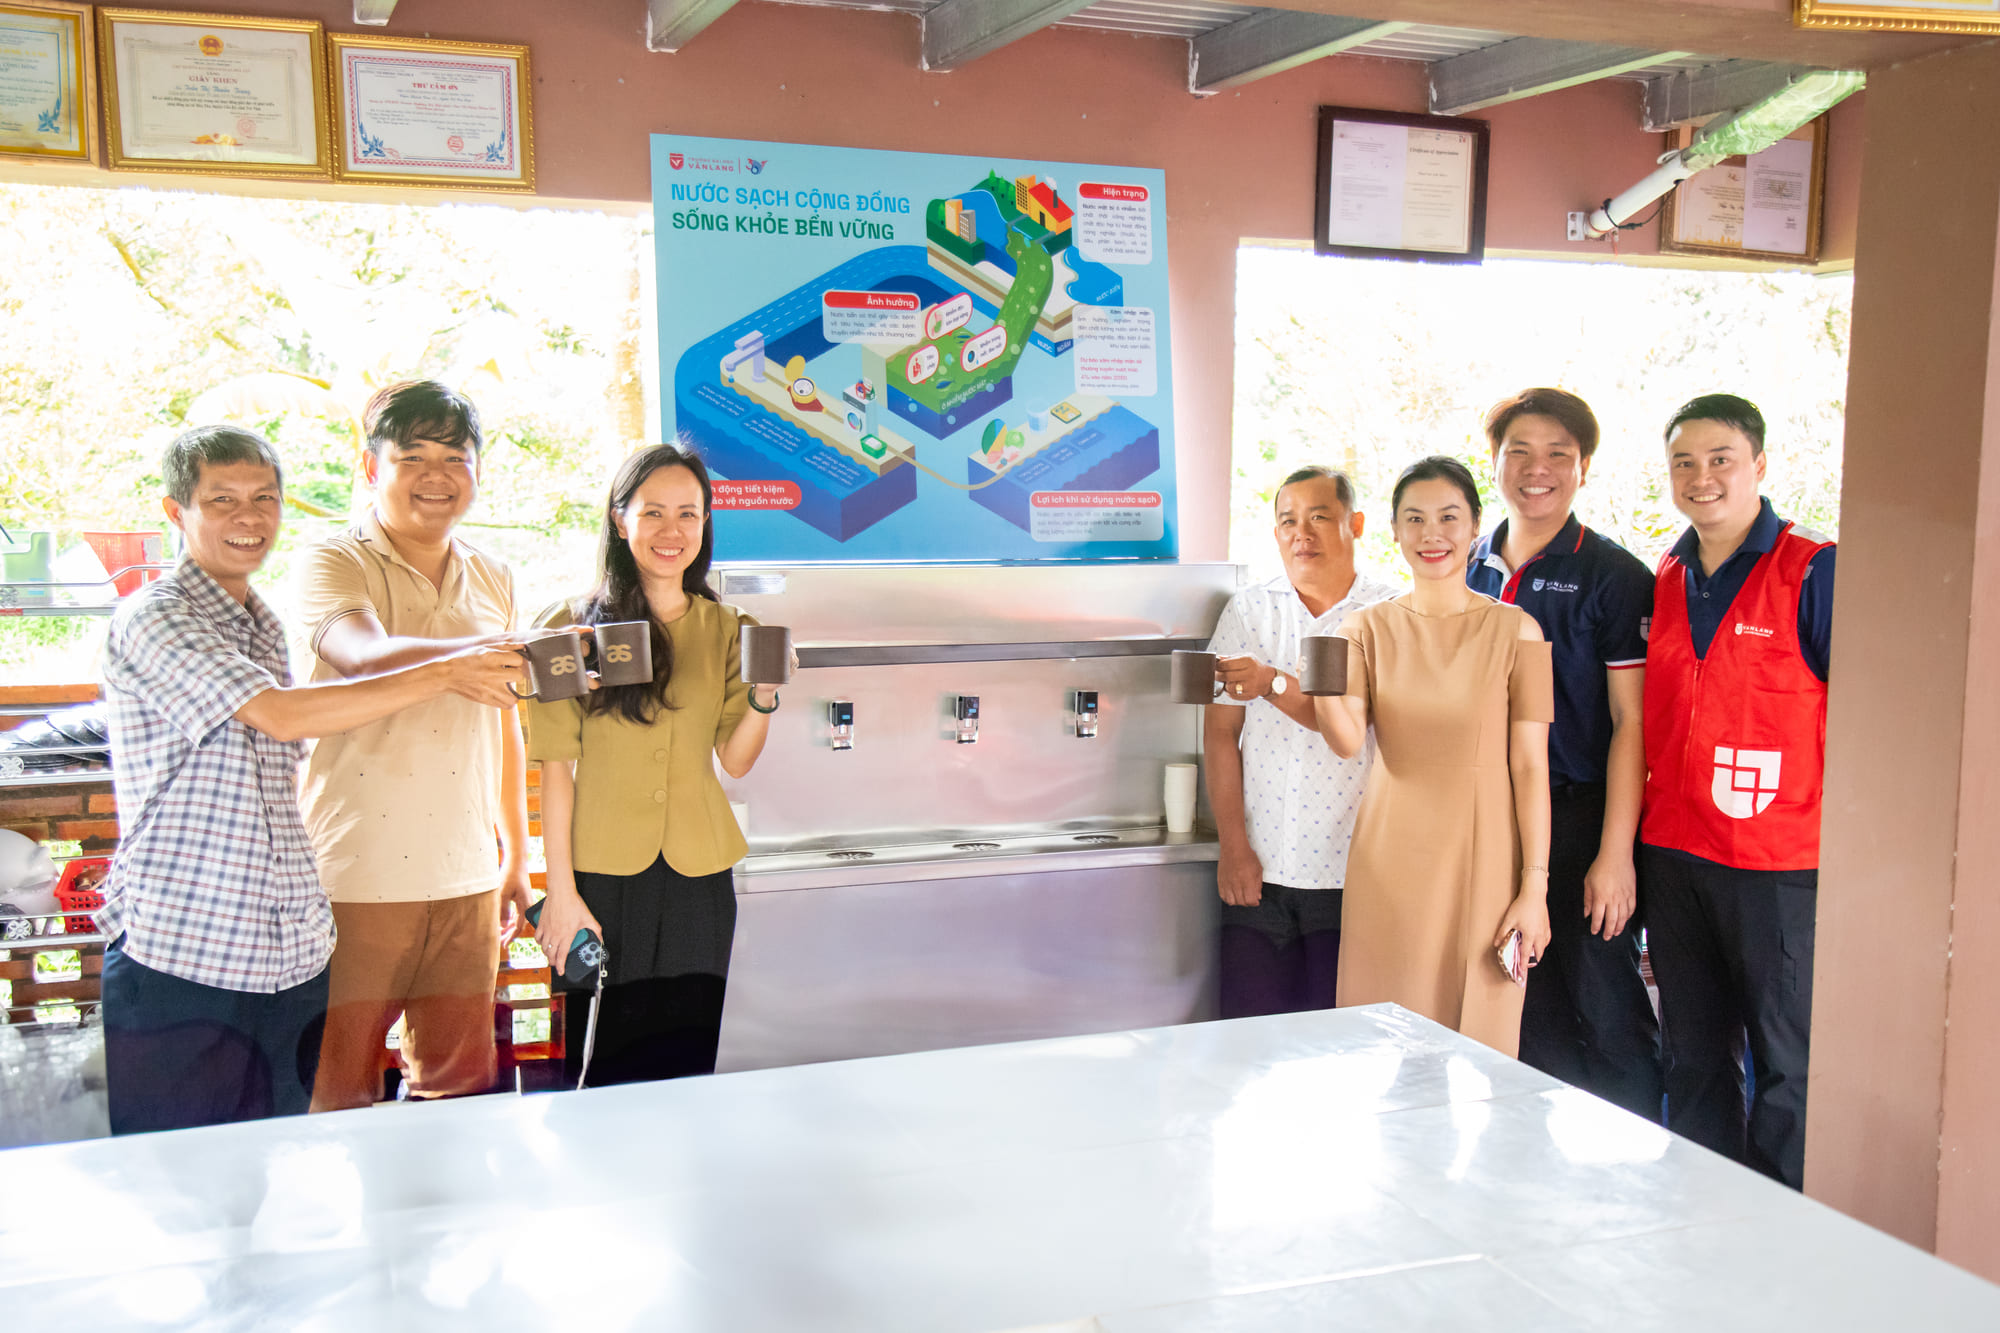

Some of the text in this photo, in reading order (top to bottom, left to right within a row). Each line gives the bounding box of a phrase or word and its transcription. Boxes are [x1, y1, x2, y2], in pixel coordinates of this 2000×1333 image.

[671, 182, 910, 214] NƯỚC SẠCH CỘNG ĐỒNG
[1103, 187, 1145, 200] Hiện trạng
[672, 208, 894, 240] SỐNG KHỎE BỀN VỮNG
[866, 294, 914, 309] Ảnh hưởng
[718, 485, 742, 495] động
[744, 484, 762, 494] tiết
[763, 484, 784, 495] kiệm
[712, 496, 794, 506] ảo vệ nguồn nước
[1037, 496, 1157, 505] Lợi ích khi sử dụng nước sạch
